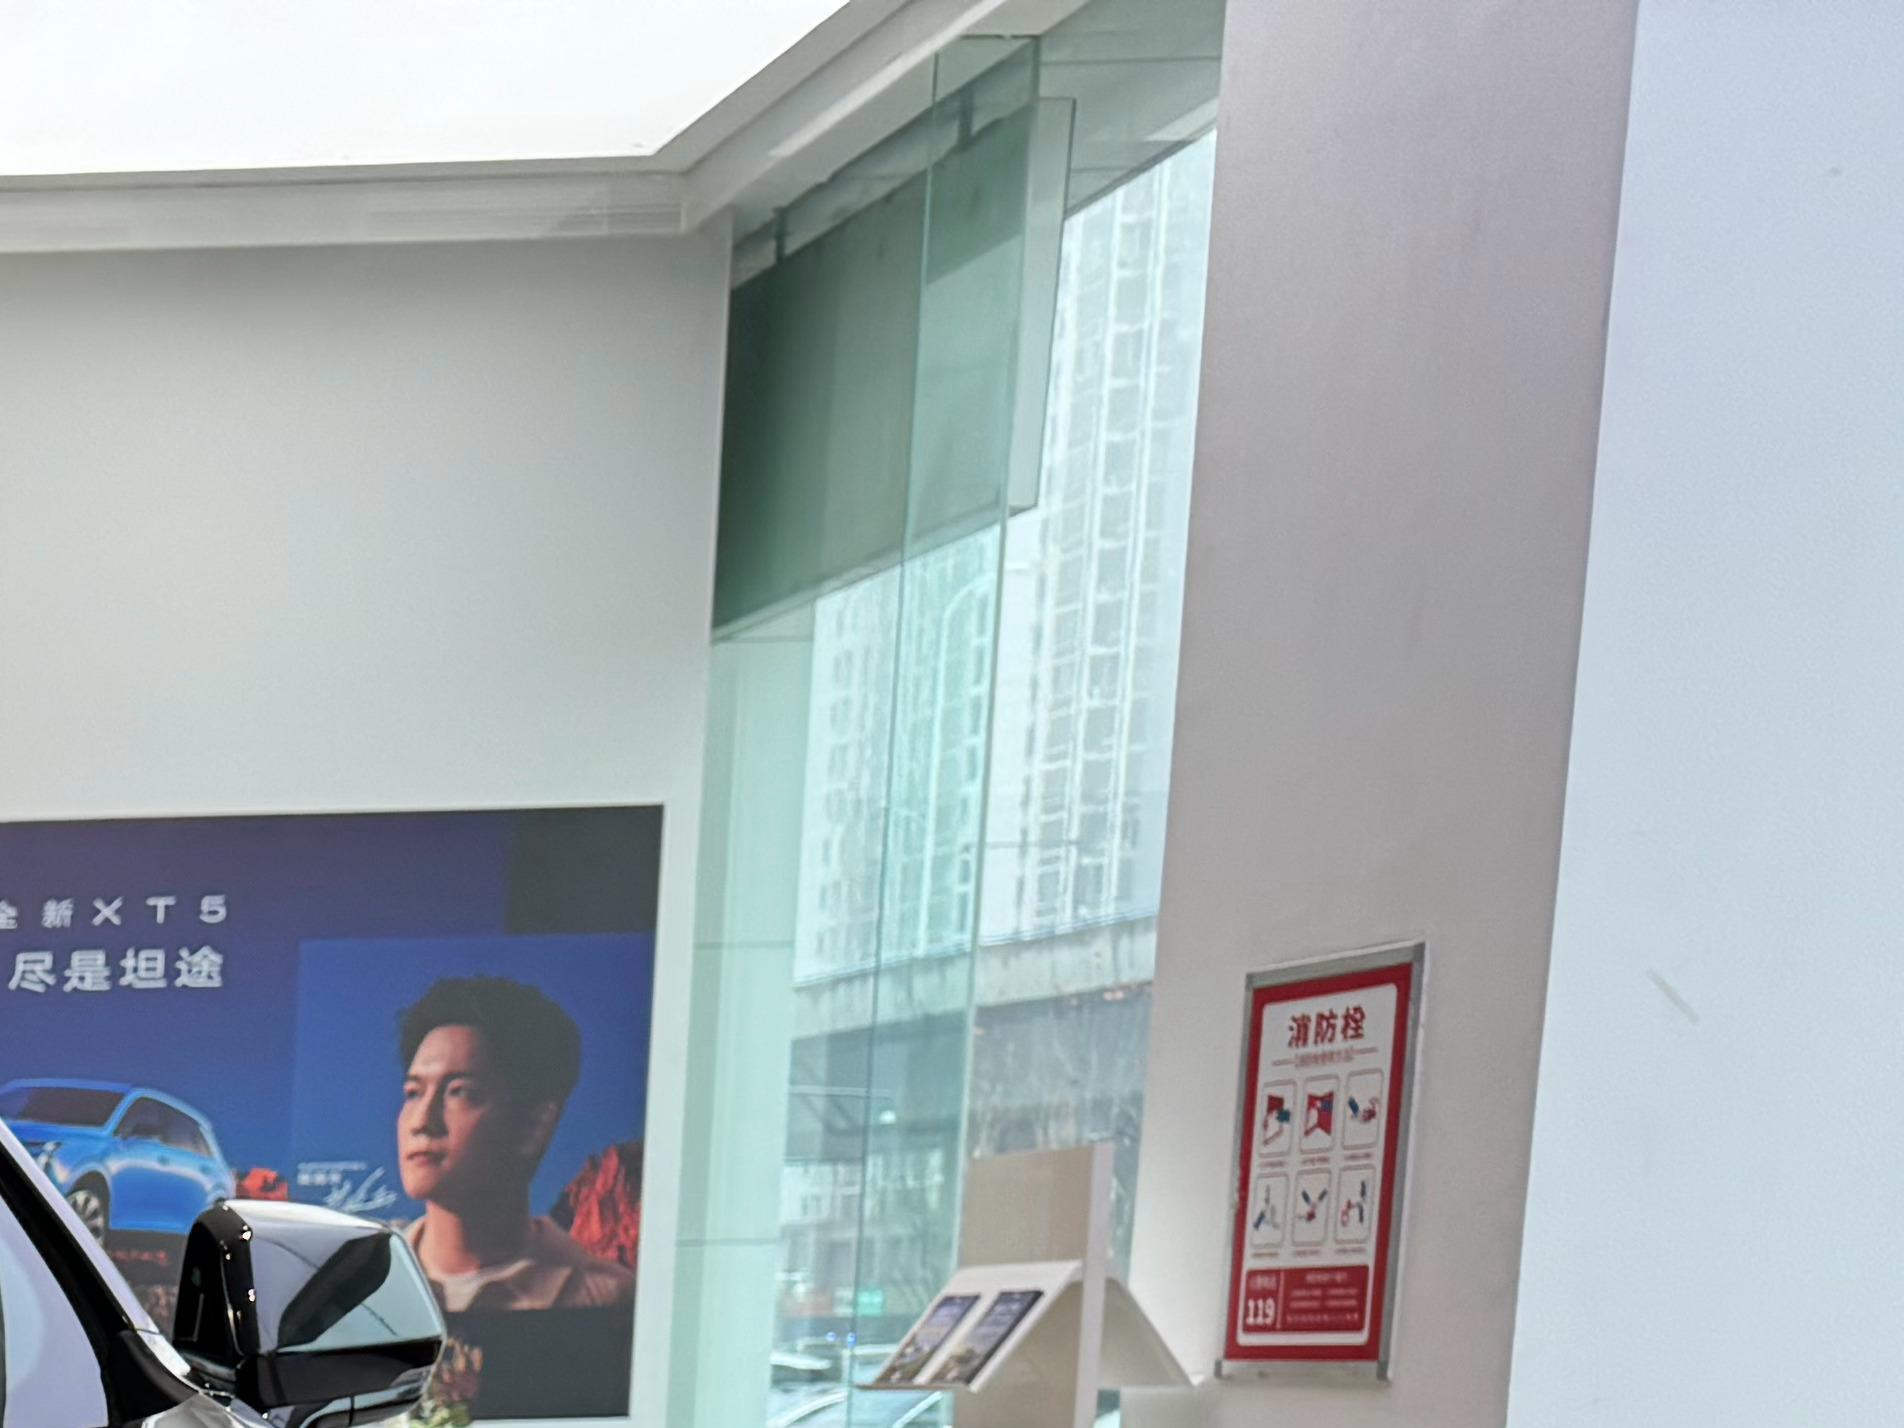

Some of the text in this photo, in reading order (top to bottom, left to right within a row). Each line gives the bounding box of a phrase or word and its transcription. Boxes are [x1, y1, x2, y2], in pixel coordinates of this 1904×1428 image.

[8, 945, 224, 993] 尽是坦途
[1288, 1005, 1366, 1048] 消防栓
[1246, 1298, 1276, 1326] 119
